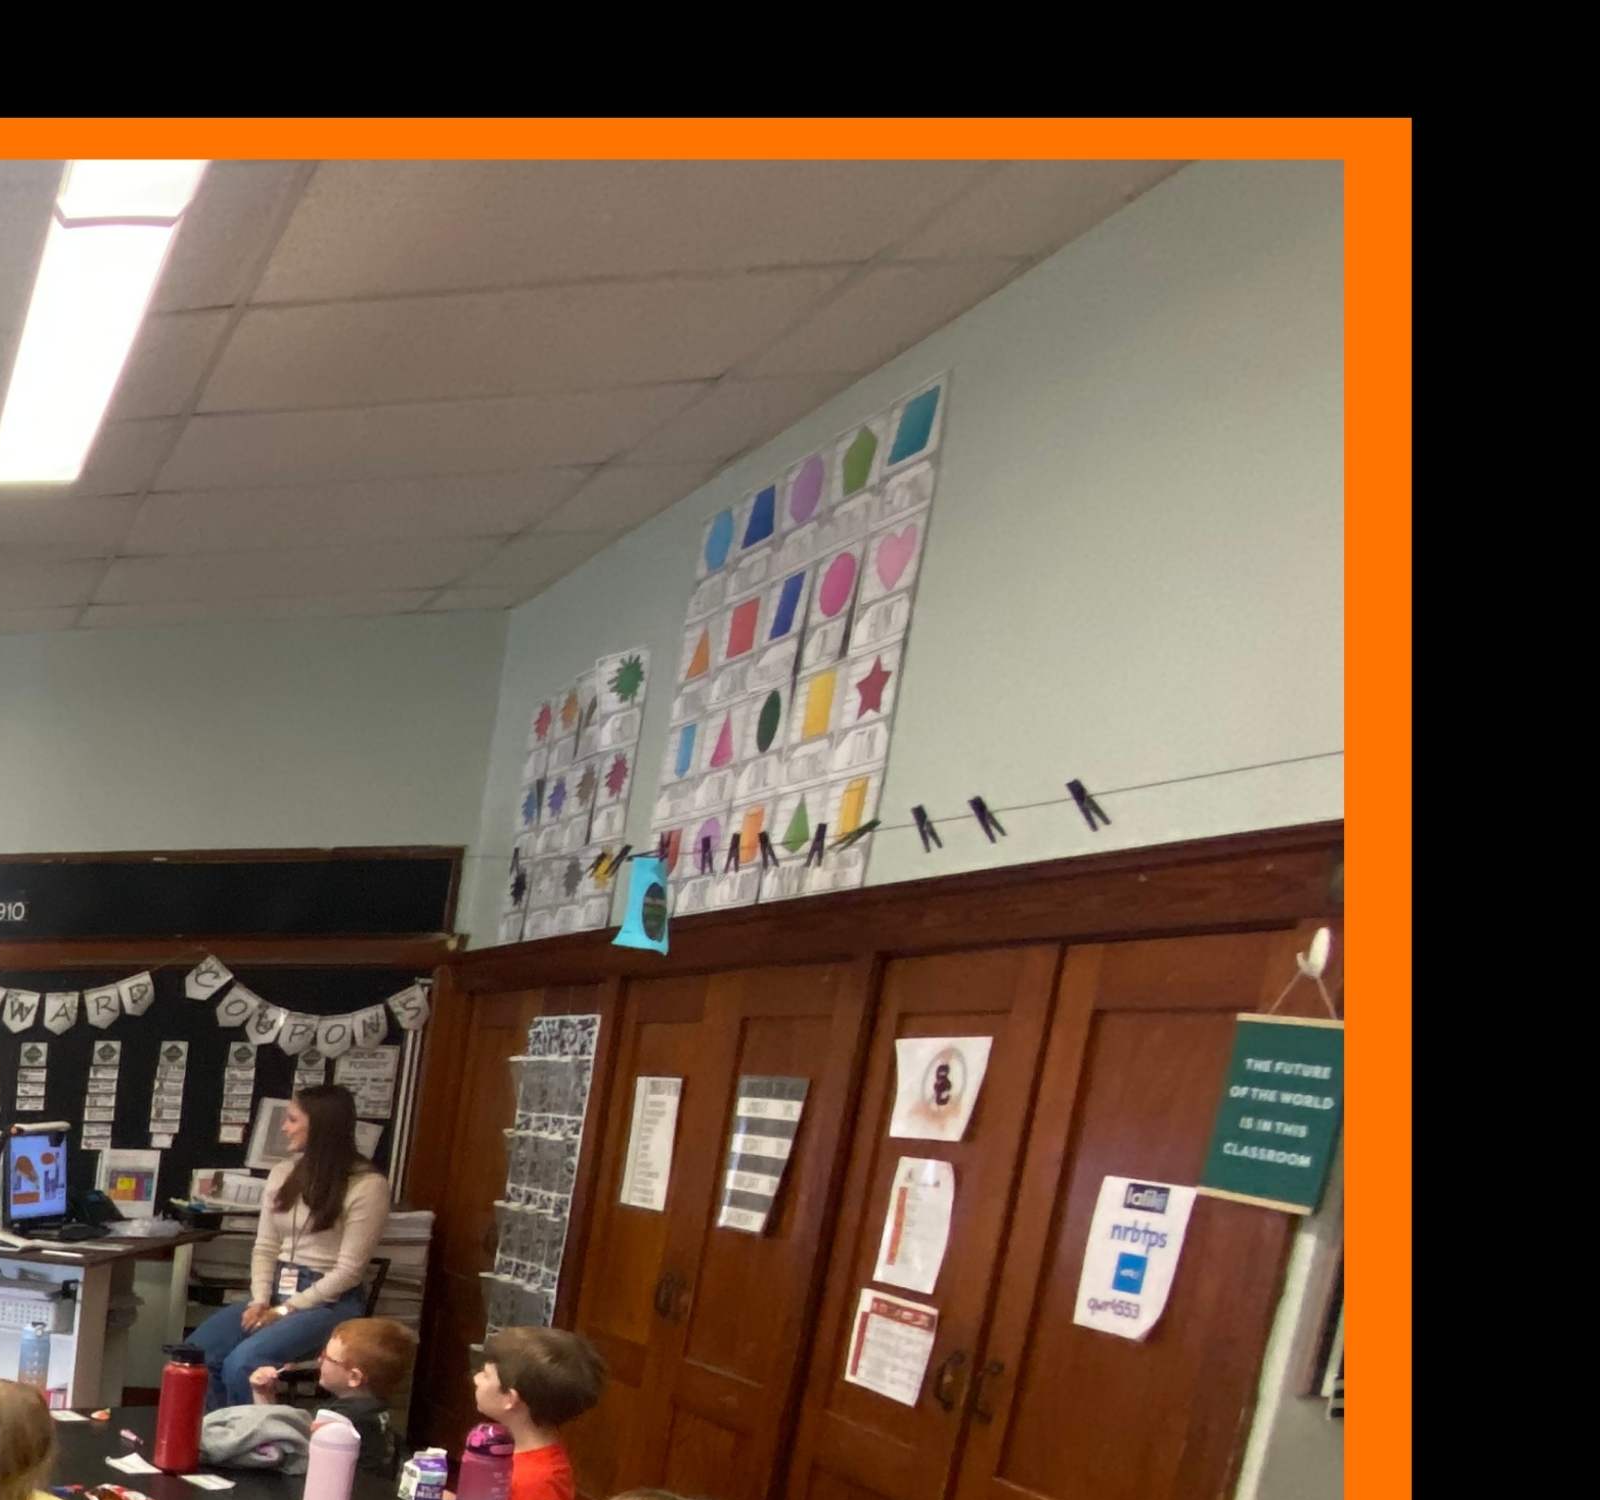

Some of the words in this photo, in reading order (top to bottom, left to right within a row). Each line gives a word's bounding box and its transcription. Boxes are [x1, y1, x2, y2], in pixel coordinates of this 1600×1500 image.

[195, 966, 423, 1044] COUPONS
[1245, 1058, 1272, 1073] THE
[1275, 1061, 1332, 1079] FUTURE
[1230, 1086, 1249, 1098] OF
[1251, 1087, 1278, 1103] THE
[1280, 1091, 1334, 1110] WORLD
[1239, 1117, 1253, 1129] IS
[1256, 1119, 1272, 1132] IN
[1275, 1121, 1308, 1138] THIS
[1223, 1142, 1311, 1168] CLASSROOM
[1111, 1219, 1168, 1255] nrbtps
